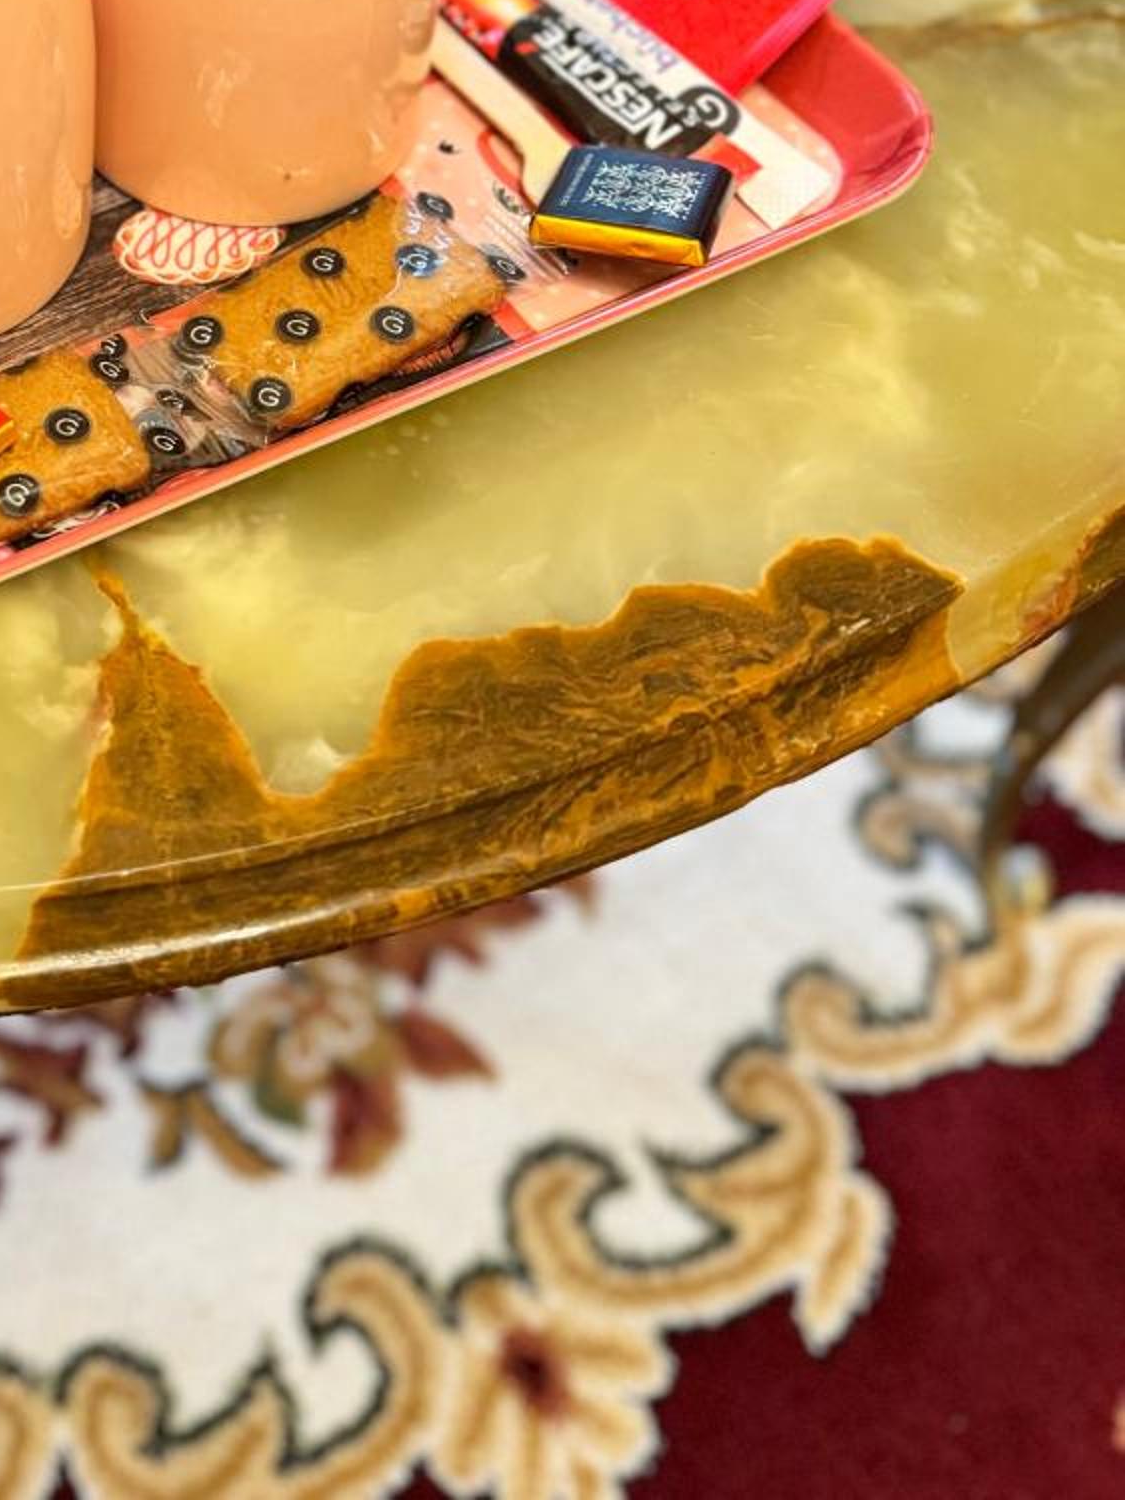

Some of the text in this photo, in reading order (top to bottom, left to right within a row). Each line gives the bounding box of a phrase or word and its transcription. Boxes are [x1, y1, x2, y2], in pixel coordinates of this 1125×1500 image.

[516, 18, 683, 150] NESCAFÉ
[312, 255, 335, 272] G
[286, 319, 310, 336] G
[382, 315, 406, 335] G
[190, 325, 213, 345] G
[98, 360, 121, 379] G
[258, 387, 282, 407] G
[55, 418, 80, 436] G
[153, 434, 176, 451] G
[5, 482, 30, 506] G
